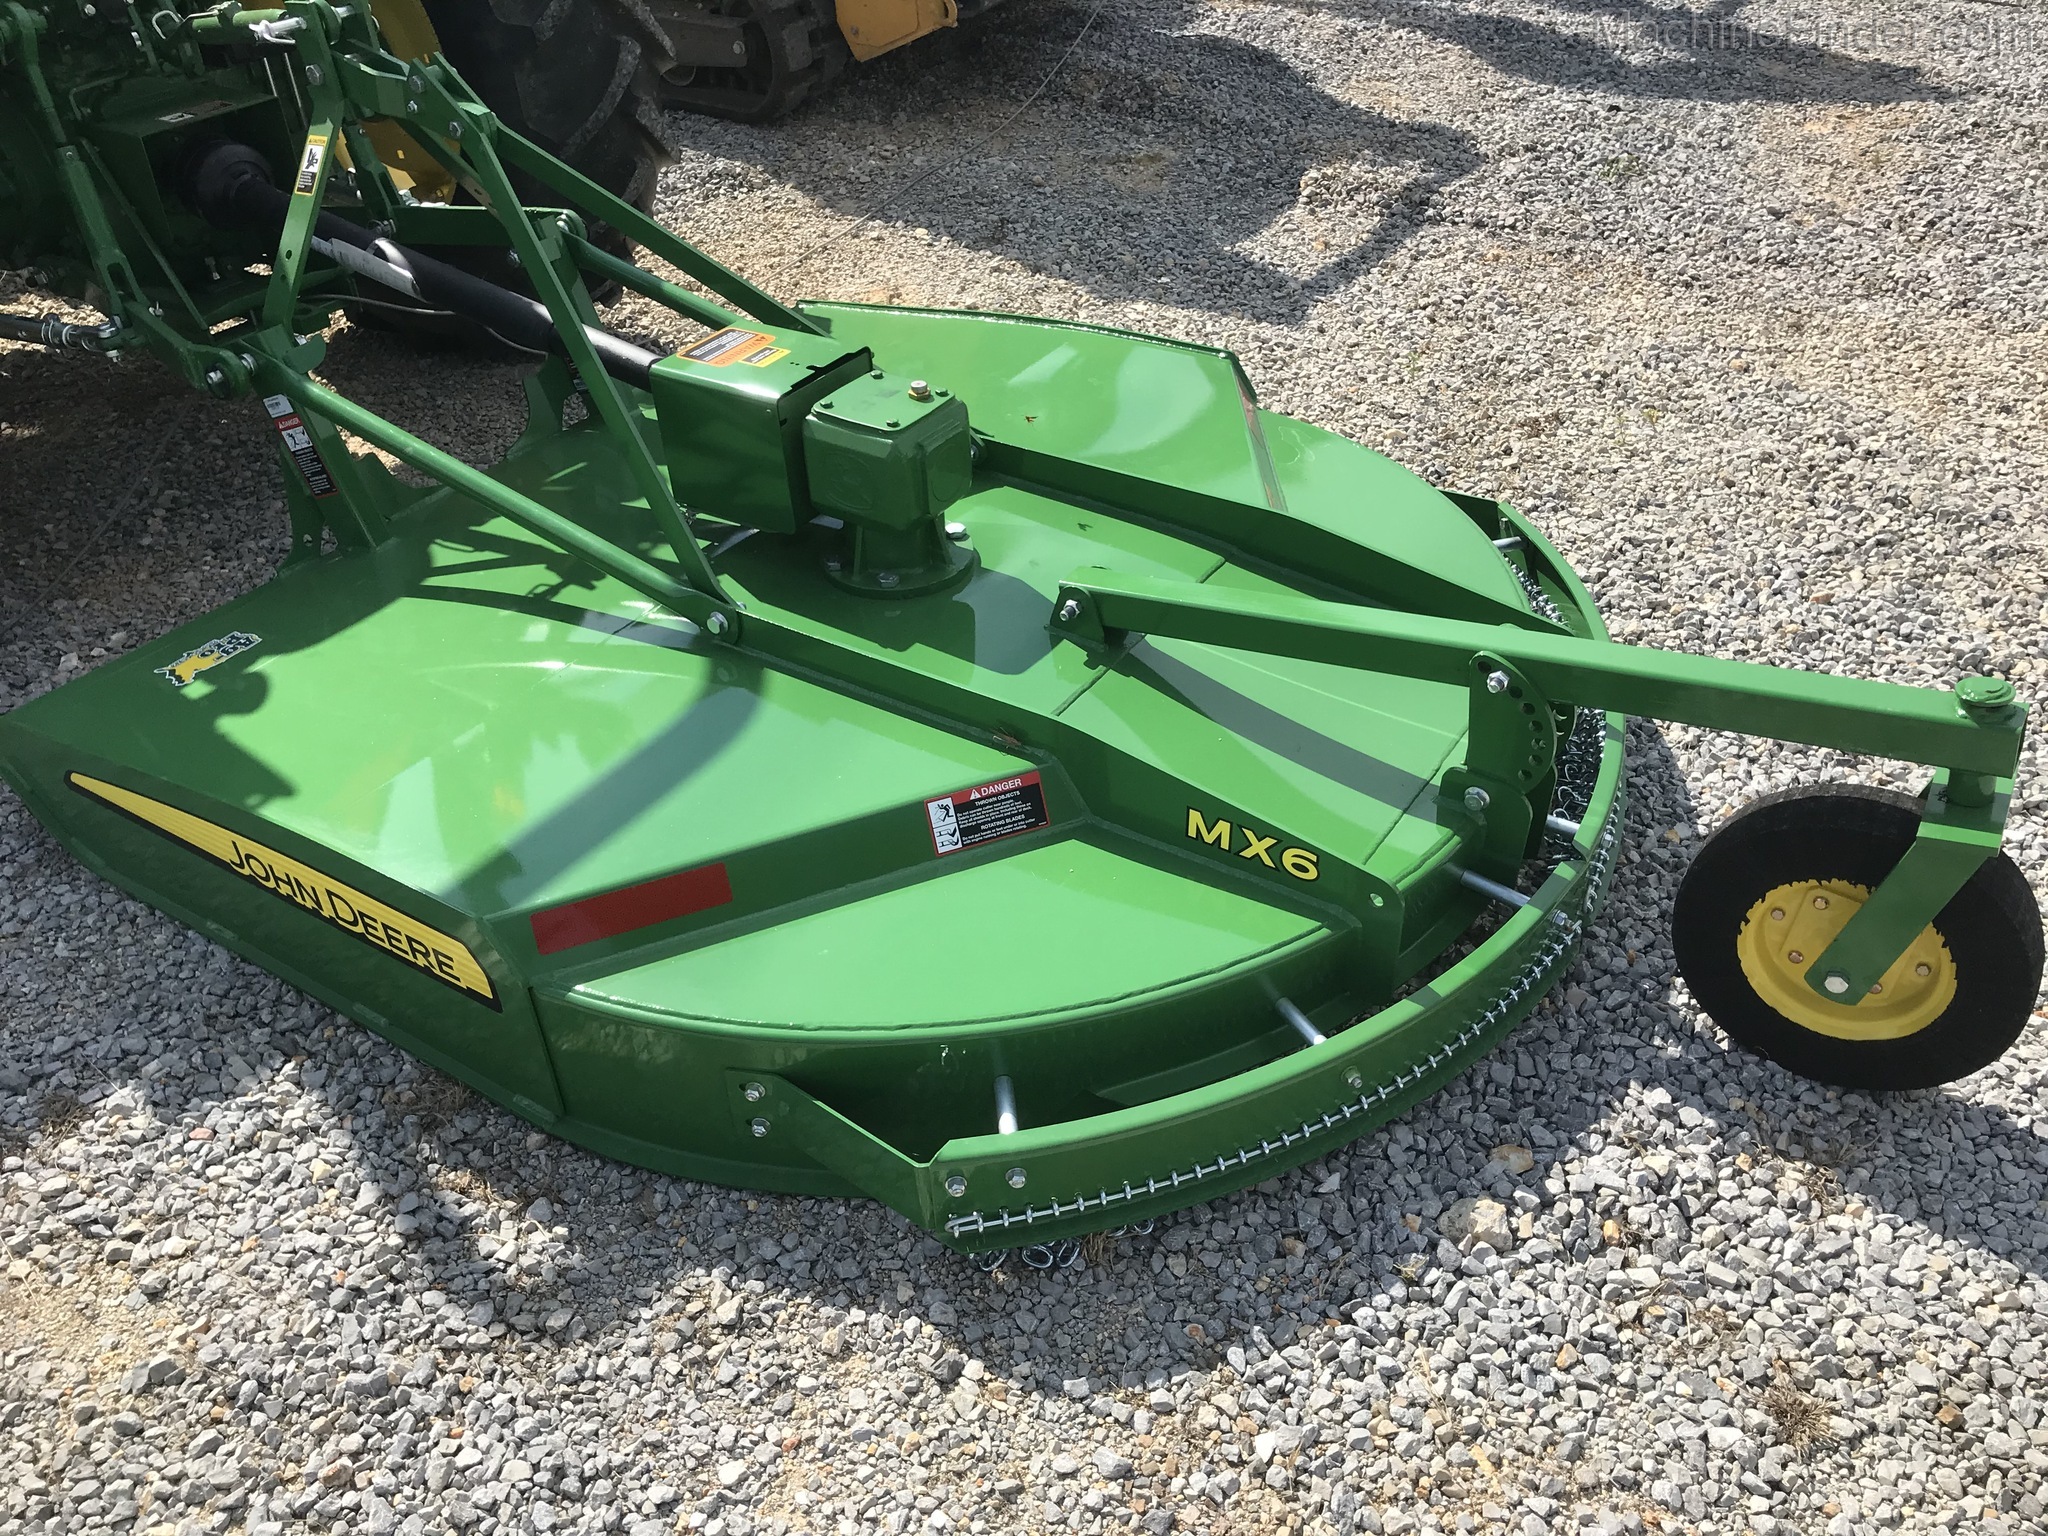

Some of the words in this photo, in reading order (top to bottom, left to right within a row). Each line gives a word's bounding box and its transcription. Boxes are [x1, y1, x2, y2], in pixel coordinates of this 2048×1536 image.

[981, 779, 1022, 796] DANGER
[998, 791, 1020, 800] OBJECTS
[980, 820, 1006, 830] ROTATING
[1006, 815, 1025, 823] BLADES
[1186, 807, 1320, 881] MX6
[228, 839, 325, 913] JOHN
[324, 887, 463, 983] DEERE
